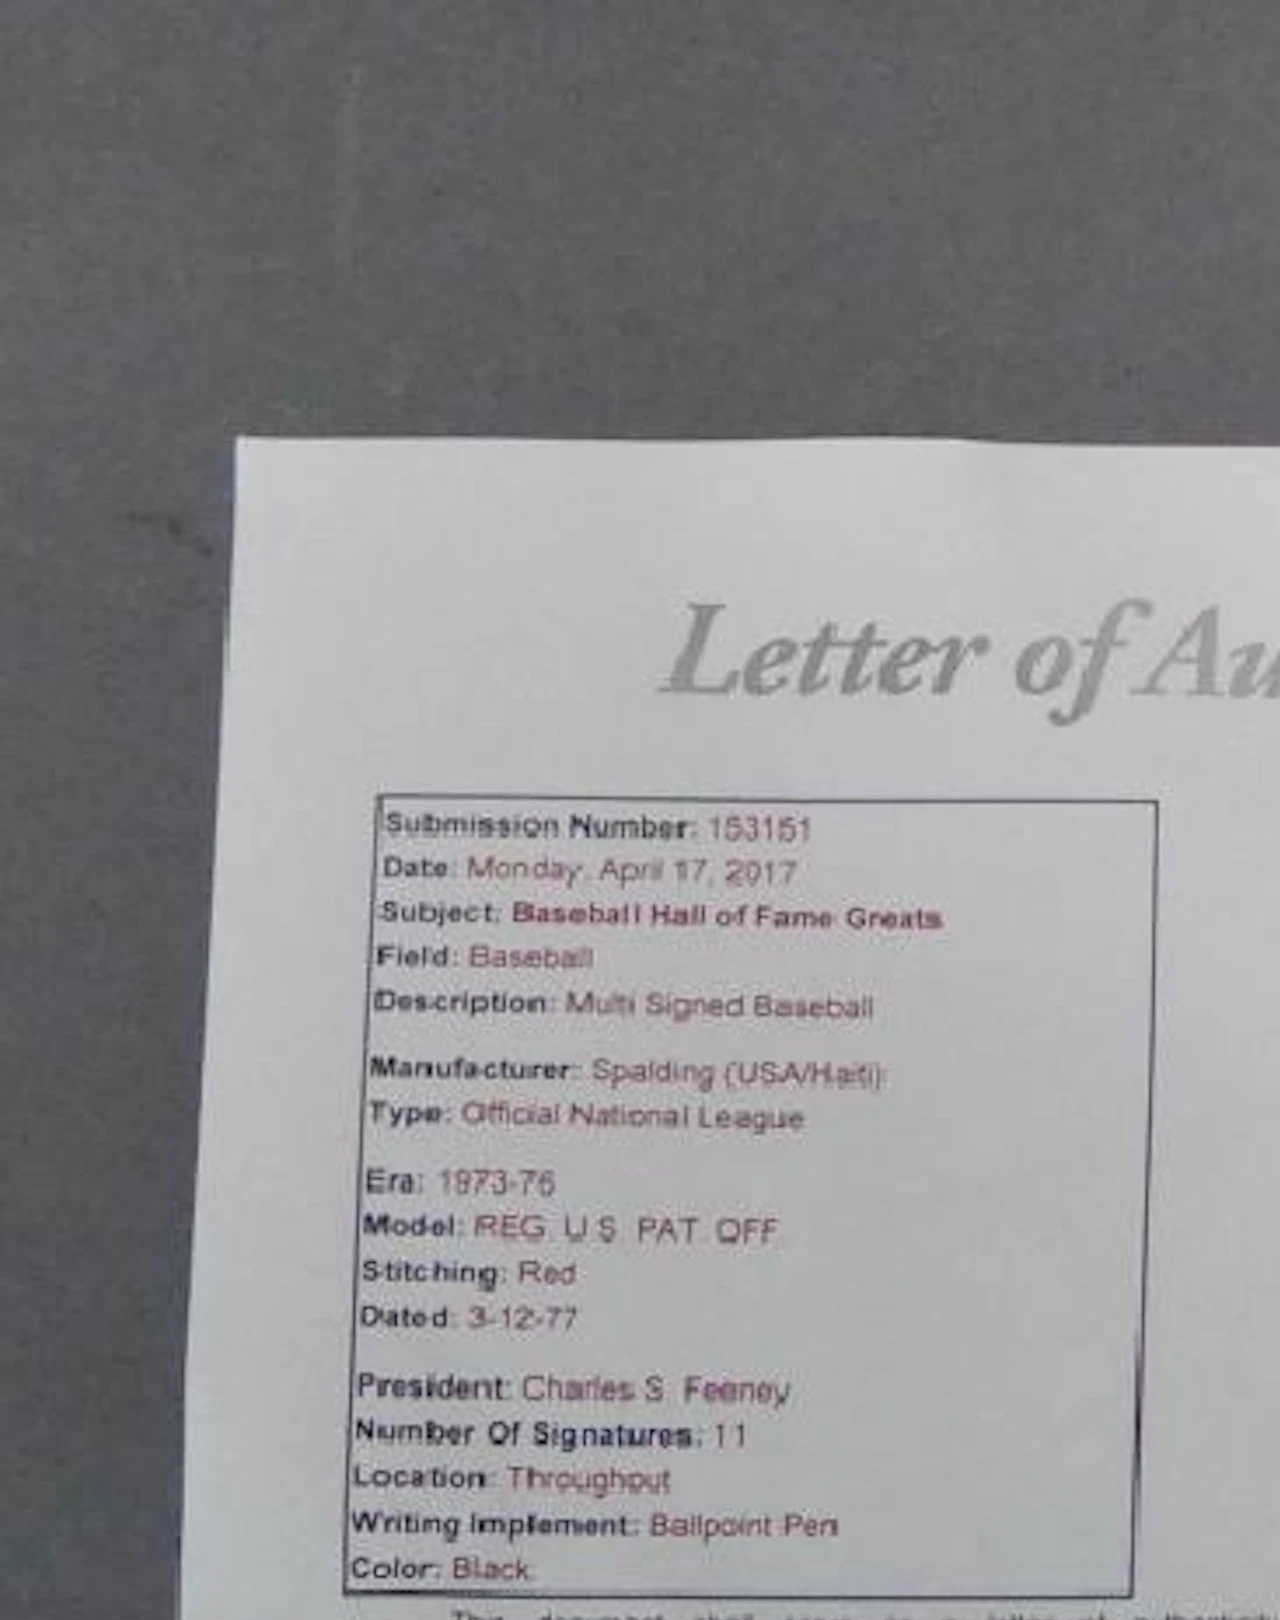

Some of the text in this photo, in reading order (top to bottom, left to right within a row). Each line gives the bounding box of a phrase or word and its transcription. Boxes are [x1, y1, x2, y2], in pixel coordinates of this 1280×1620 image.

[656, 600, 990, 697] Letter
[1014, 598, 1156, 728] of
[383, 812, 561, 838] Submission
[709, 814, 810, 844] 153151
[597, 857, 665, 890] April
[723, 857, 798, 888] 2017
[380, 900, 945, 932] Subject: Baseball Hall of Fame Greats
[375, 943, 594, 971] Field: Baseball
[373, 989, 874, 1024] Description: Multi Signed Baseball
[591, 1056, 716, 1093] Spalding
[367, 1097, 806, 1136] Type: Official National League
[365, 1167, 556, 1199] Era: 1973-76
[361, 1259, 577, 1292] Stitching: Red
[468, 1304, 578, 1332] 3-12-77
[356, 1372, 513, 1402] President:
[521, 1373, 637, 1403] Charles
[683, 1374, 792, 1410] Feeney
[354, 1420, 747, 1455] Number Of Signatures: 11
[506, 1465, 671, 1499] Throughout
[350, 1511, 462, 1544] Writing
[649, 1511, 773, 1545] Ballpoint
[783, 1512, 839, 1538] Pen
[349, 1555, 532, 1583] Color: Black
